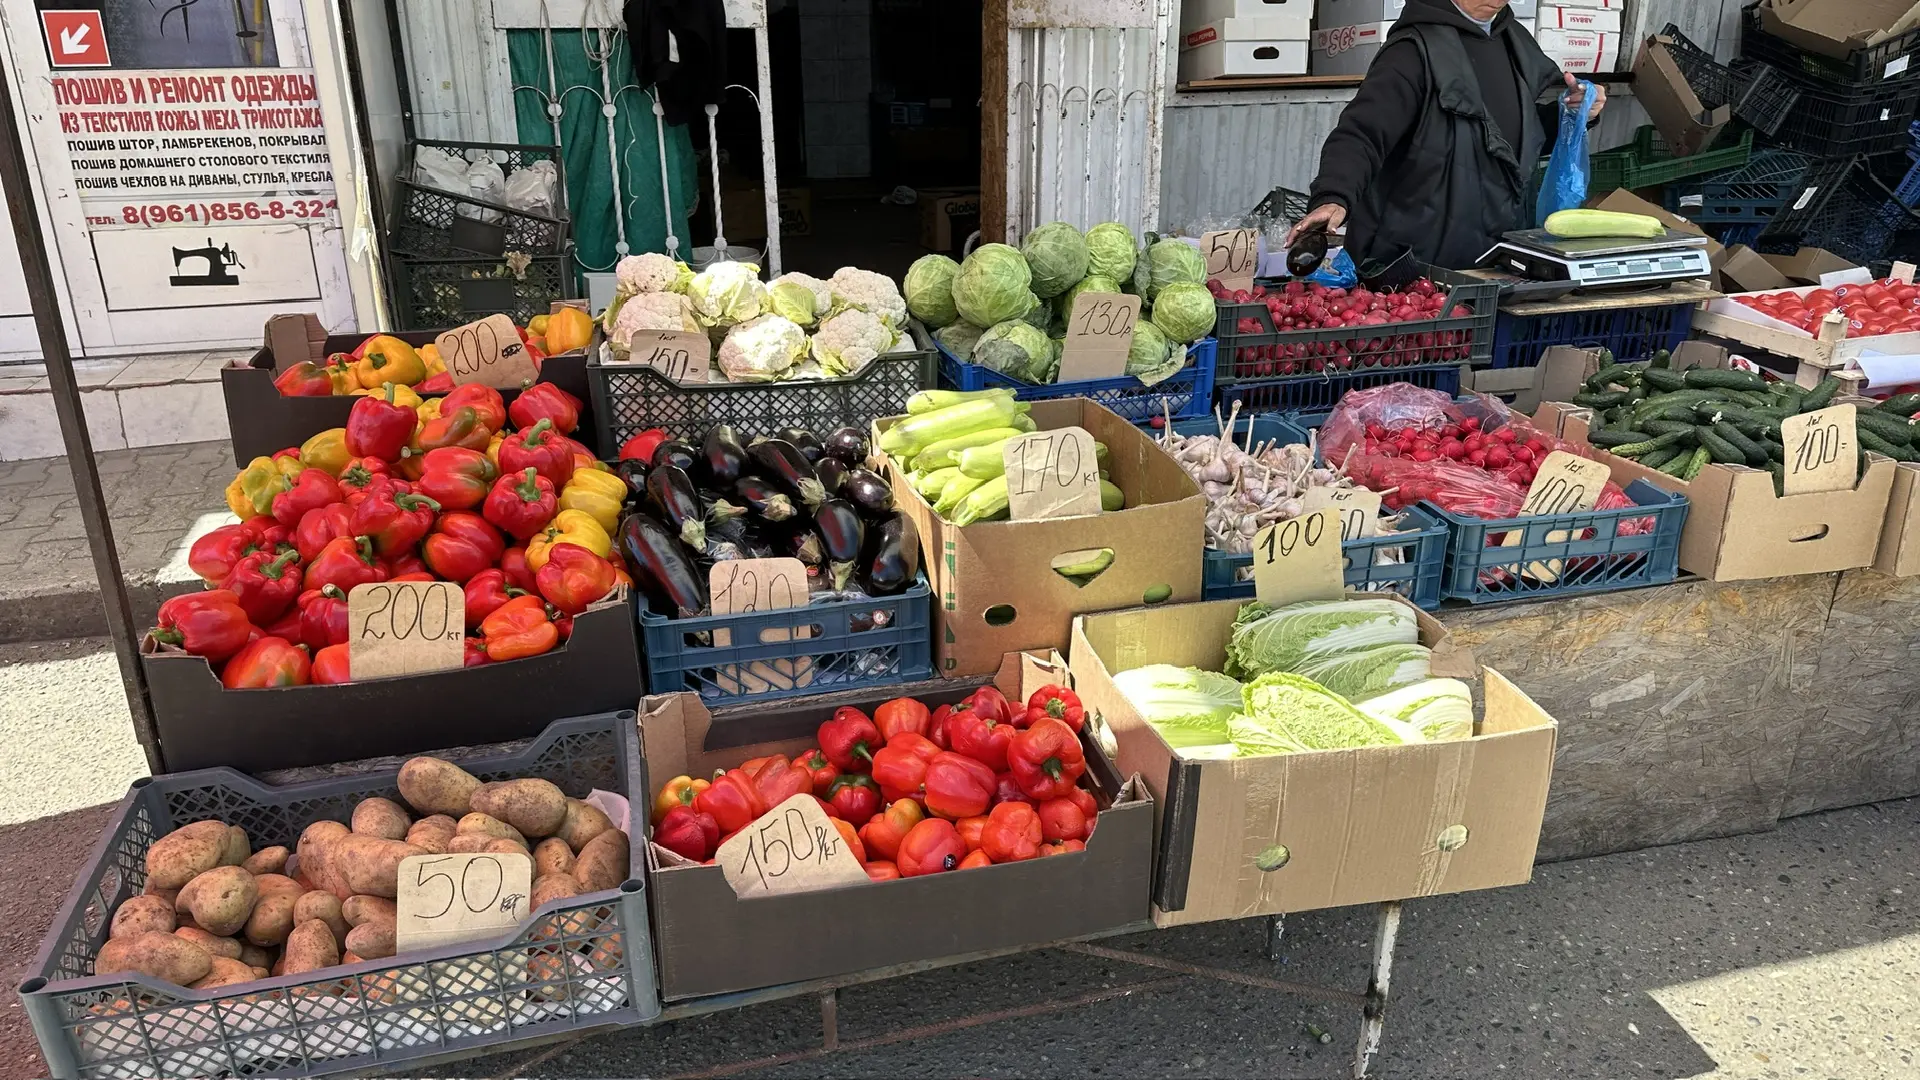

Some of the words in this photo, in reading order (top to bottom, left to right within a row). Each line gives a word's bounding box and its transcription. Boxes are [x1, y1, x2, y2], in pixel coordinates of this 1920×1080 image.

[51, 77, 128, 105] ПОШИВ
[128, 77, 147, 104] И
[147, 76, 226, 103] РЕМОНТ
[231, 75, 318, 107] ОДЕЖДЫ
[59, 112, 80, 133] ИЗ
[80, 110, 155, 132] ТЕКСТИЛЯ
[155, 110, 201, 131] КОЖЫ
[201, 108, 241, 130] МЕХА
[241, 107, 324, 129] ТРИКОТАЖА
[67, 140, 116, 151] ПОШИВ
[118, 139, 160, 151] ШТОР,
[162, 136, 257, 149] ЛАМБРЕКЕНОВ,
[259, 135, 327, 147] ПОКРЫВАЛ
[71, 159, 116, 170] ПОШИВ
[120, 156, 196, 170] ДОМАШНЕГО
[199, 155, 268, 167] СТОЛОВОГО
[271, 153, 331, 165] ТЕКСТИЛЯ
[75, 177, 118, 189] ПОШИВ
[120, 175, 167, 188] ЧЕХЛОВ
[169, 175, 186, 187] НА
[188, 173, 241, 187] ДИВАНЫ,
[243, 171, 289, 185] СТУЛЬЯ,
[291, 171, 334, 183] КРЕСЛА
[443, 322, 498, 376] 200
[1013, 433, 1081, 494] 170
[1259, 512, 1324, 565] 100
[361, 583, 449, 641] 200
[714, 563, 794, 615] 120
[740, 808, 814, 890] 150
[413, 856, 503, 919] 50
